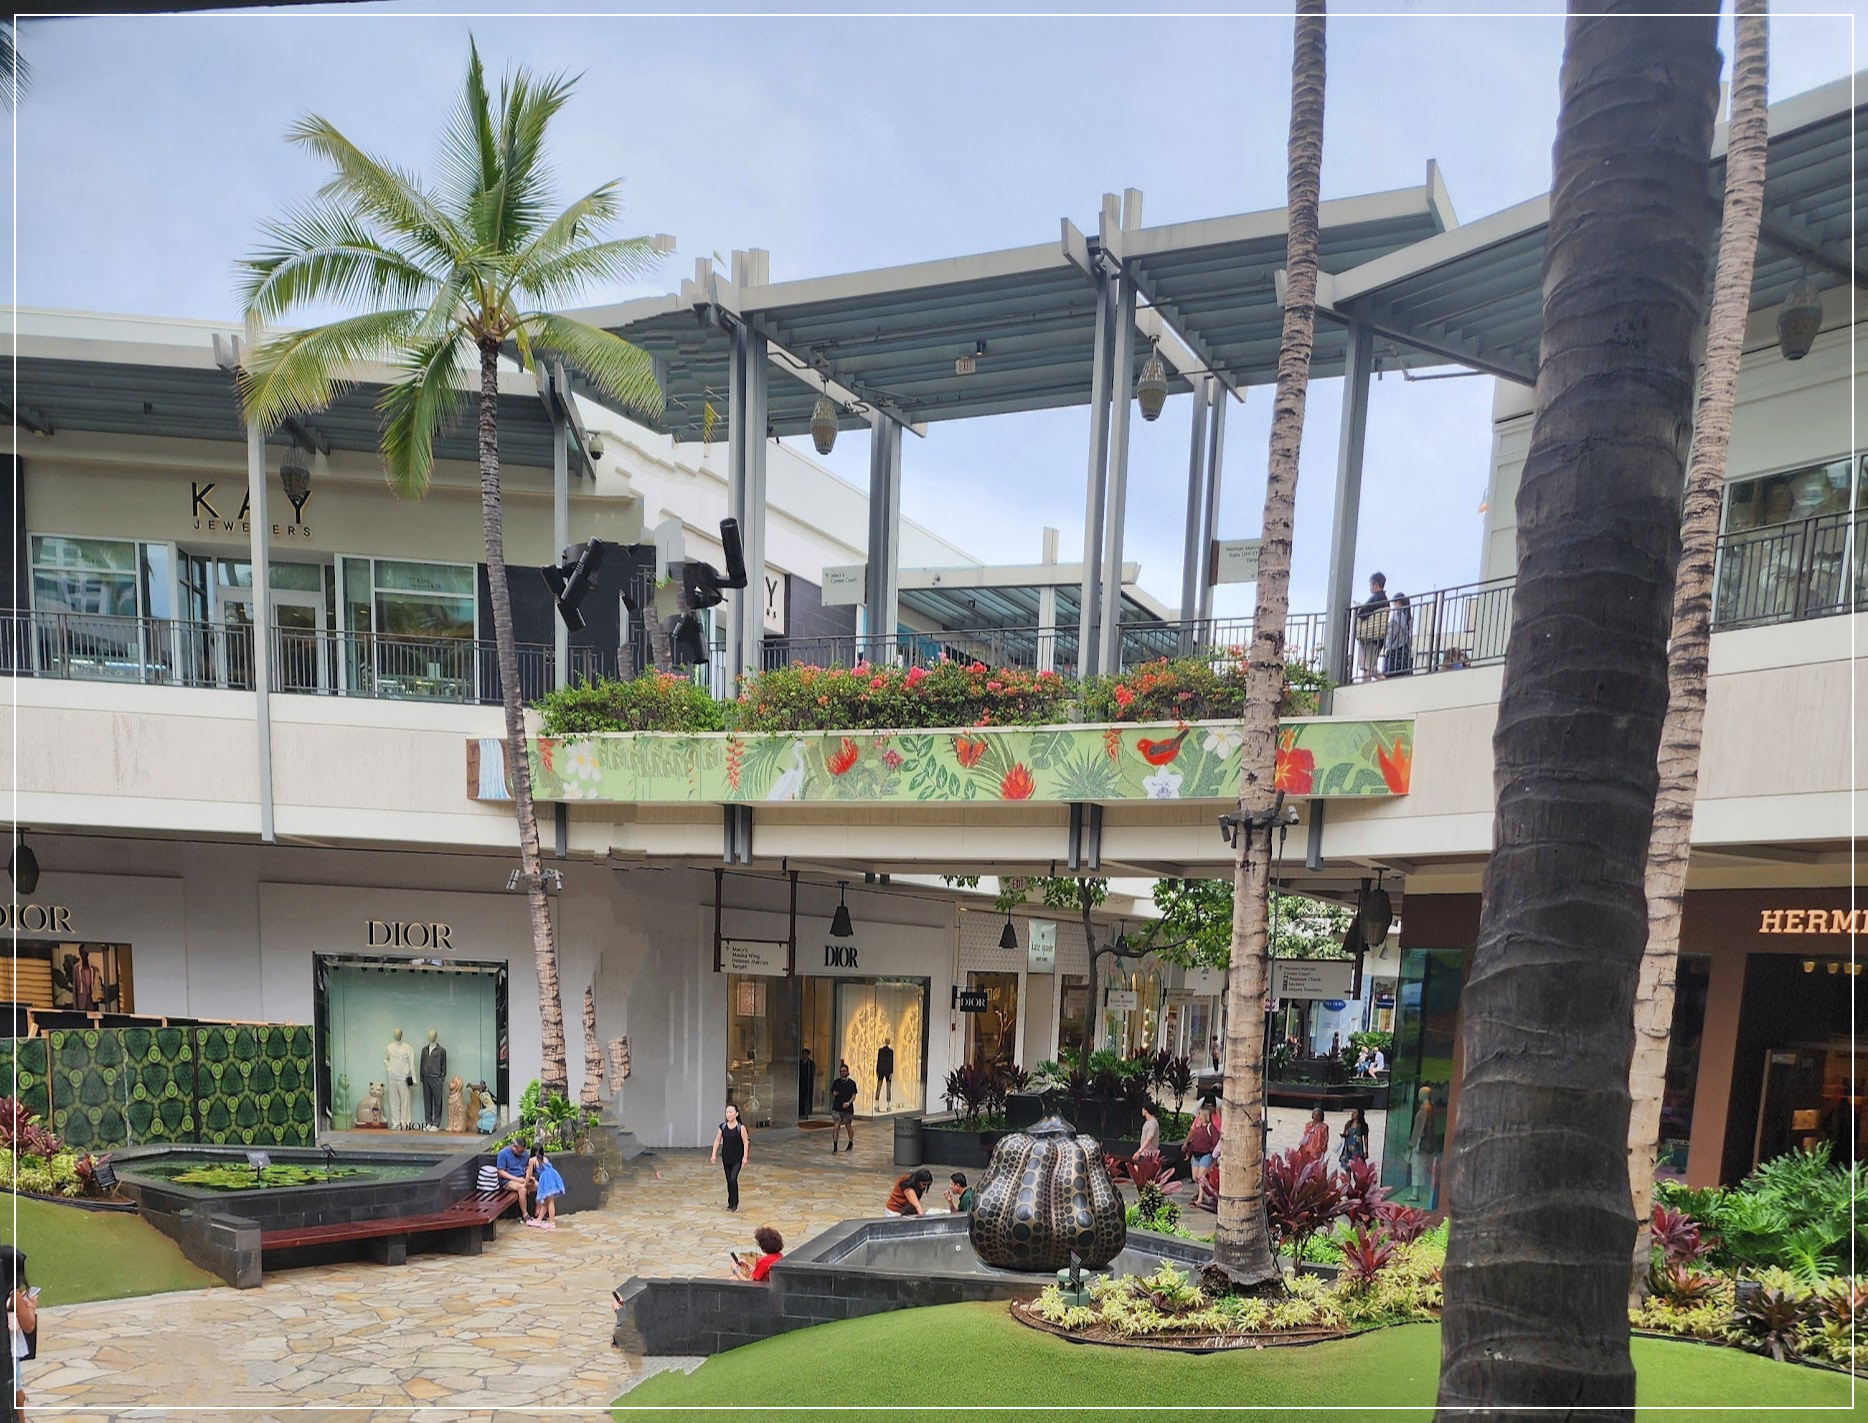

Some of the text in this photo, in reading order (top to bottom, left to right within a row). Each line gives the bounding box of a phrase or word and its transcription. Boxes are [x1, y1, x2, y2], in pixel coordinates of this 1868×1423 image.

[194, 520, 310, 537] JEWEERS
[366, 921, 456, 951] DIOR
[824, 945, 858, 968] DIOR
[960, 996, 986, 1008] DIOR
[400, 1121, 429, 1132] DIOR
